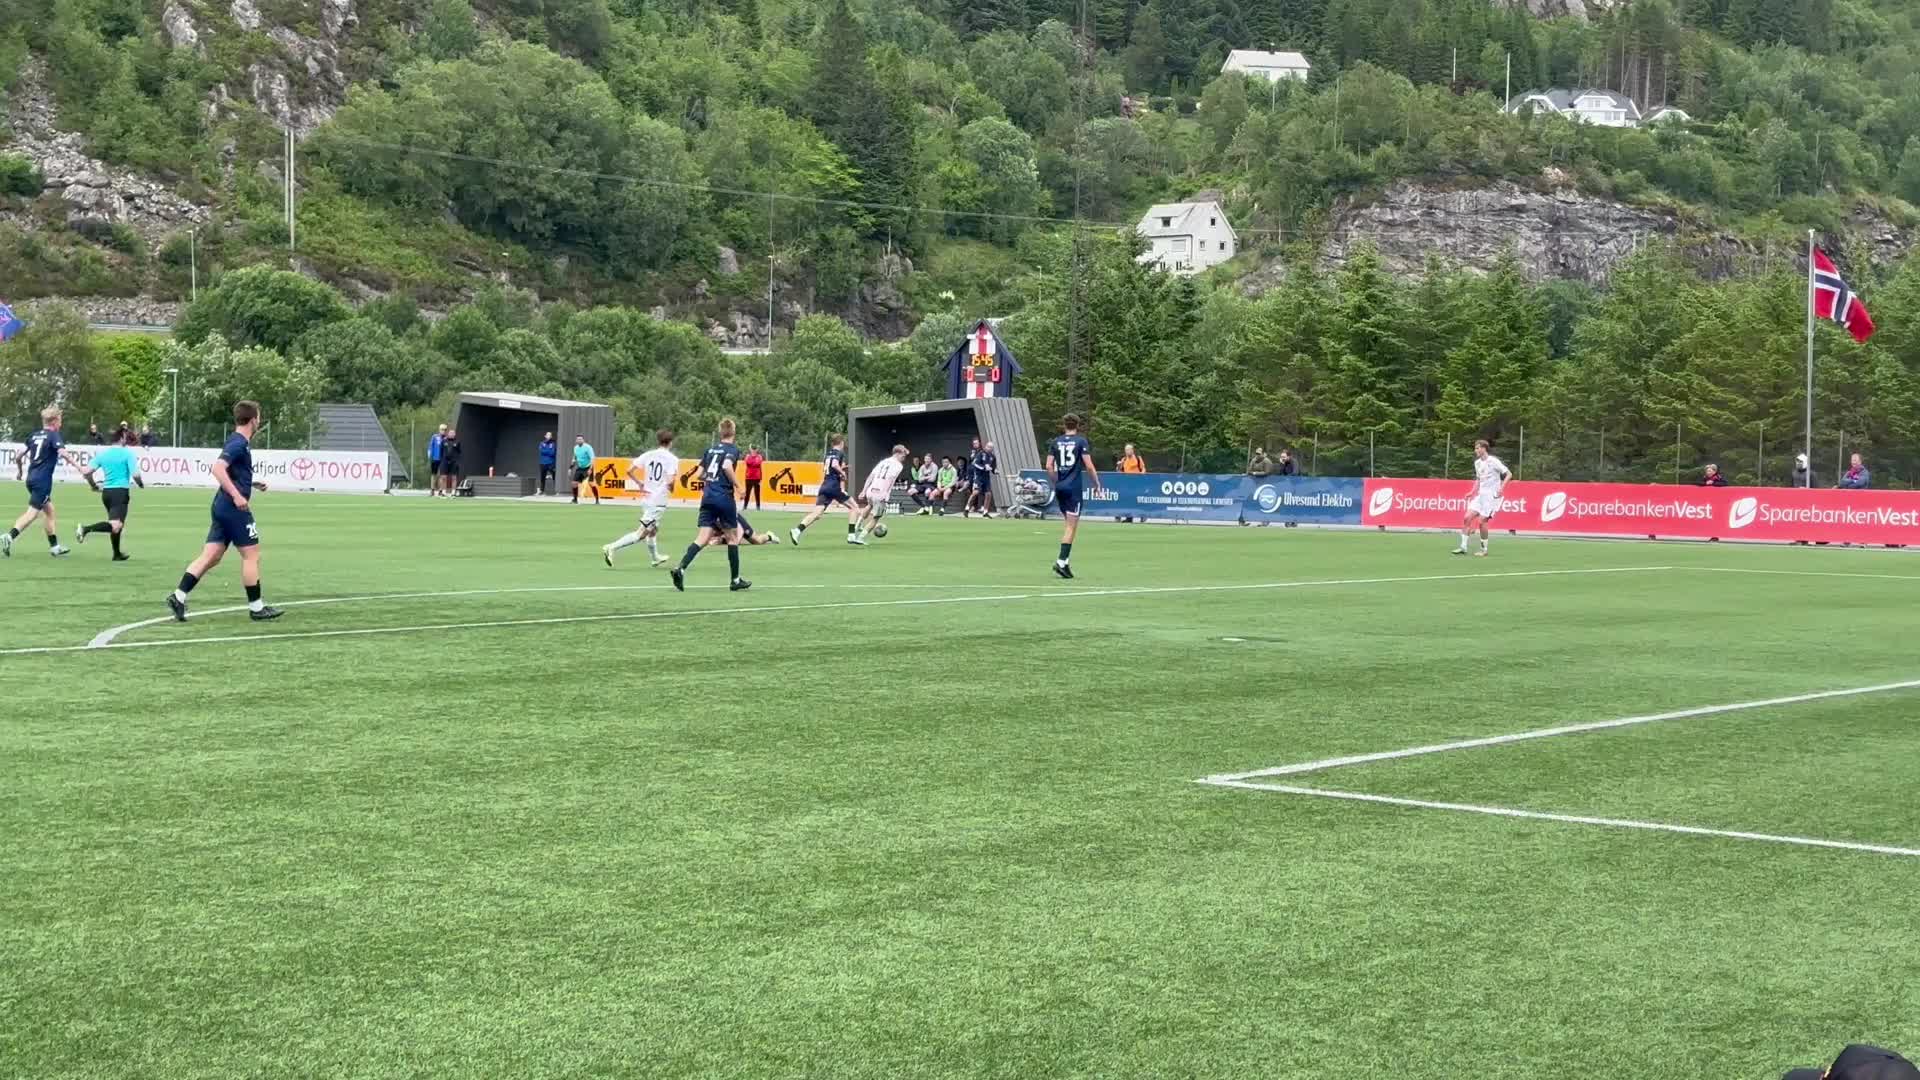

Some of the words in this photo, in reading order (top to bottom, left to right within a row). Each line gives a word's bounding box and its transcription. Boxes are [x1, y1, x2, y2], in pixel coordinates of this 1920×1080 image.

[33, 439, 44, 461] 7
[1058, 444, 1076, 467] 13
[137, 457, 191, 475] OYOTA
[319, 461, 383, 480] TOYOTA
[649, 460, 663, 482] 10
[706, 454, 719, 479] 4
[1283, 491, 1320, 507] Ulvesund
[1322, 493, 1353, 508] Elektro
[1567, 497, 1713, 519] SparebankenVest
[1759, 504, 1919, 526] SparebankenVest
